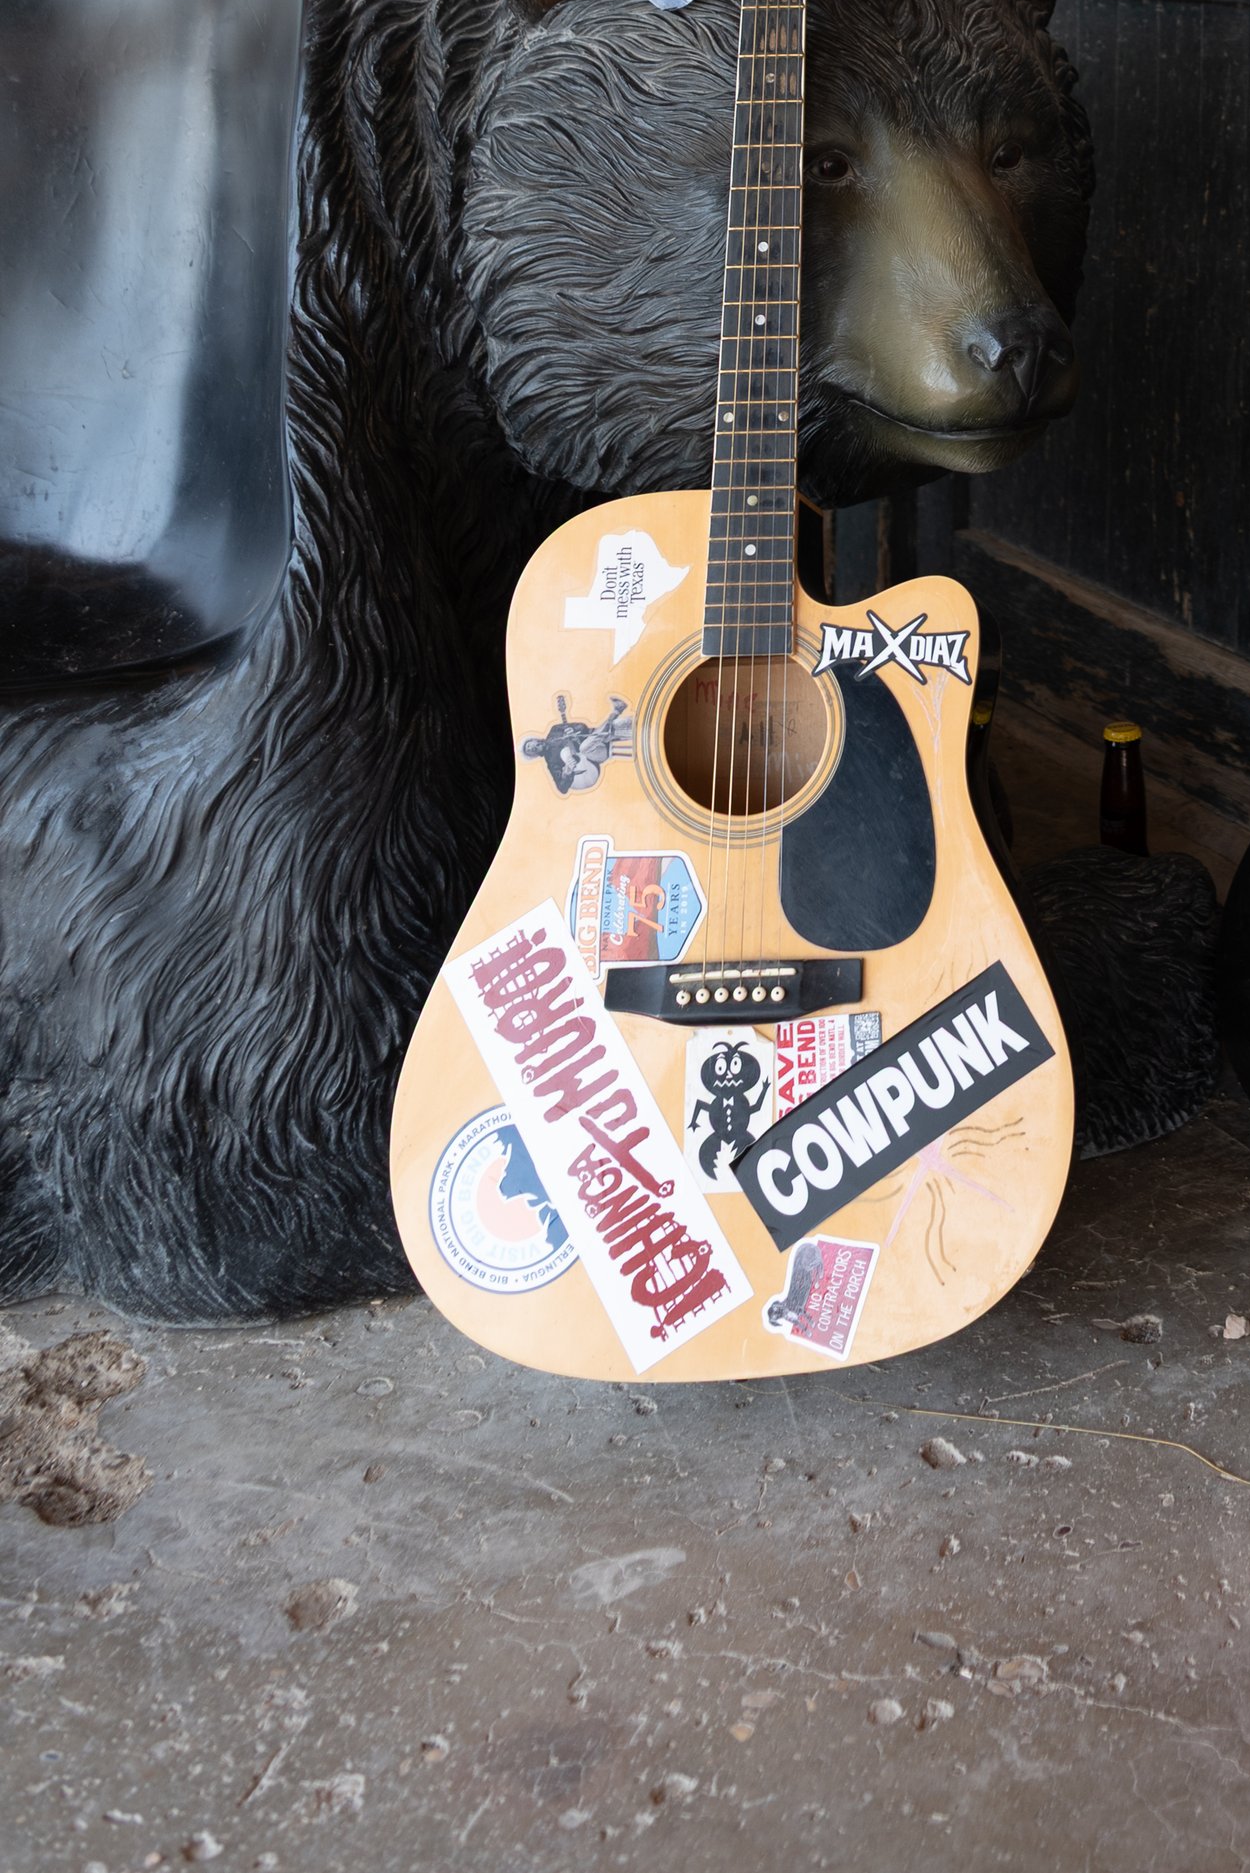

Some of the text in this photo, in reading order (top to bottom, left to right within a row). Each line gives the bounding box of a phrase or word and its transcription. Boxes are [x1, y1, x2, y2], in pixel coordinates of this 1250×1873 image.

[600, 566, 618, 600] Don't
[616, 546, 632, 618] mess with
[630, 562, 646, 604] Texas
[813, 612, 972, 683] MAX DIAZ
[580, 846, 604, 919] BEND
[602, 869, 613, 951] NATIONAL PARK
[610, 874, 630, 946] Celebrating
[627, 884, 666, 937] 75
[668, 883, 680, 937] YEARS
[797, 1020, 816, 1085] BEND
[757, 990, 1030, 1216] COWPUNK
[438, 1161, 455, 1193] PARK
[437, 1198, 459, 1257] NATIONAL
[459, 1257, 487, 1280] BEND
[489, 1273, 509, 1285] BIG
[817, 1249, 852, 1332] CONTRACTORS
[808, 1293, 823, 1311] NO
[829, 1260, 867, 1349] ON THE PORCH
